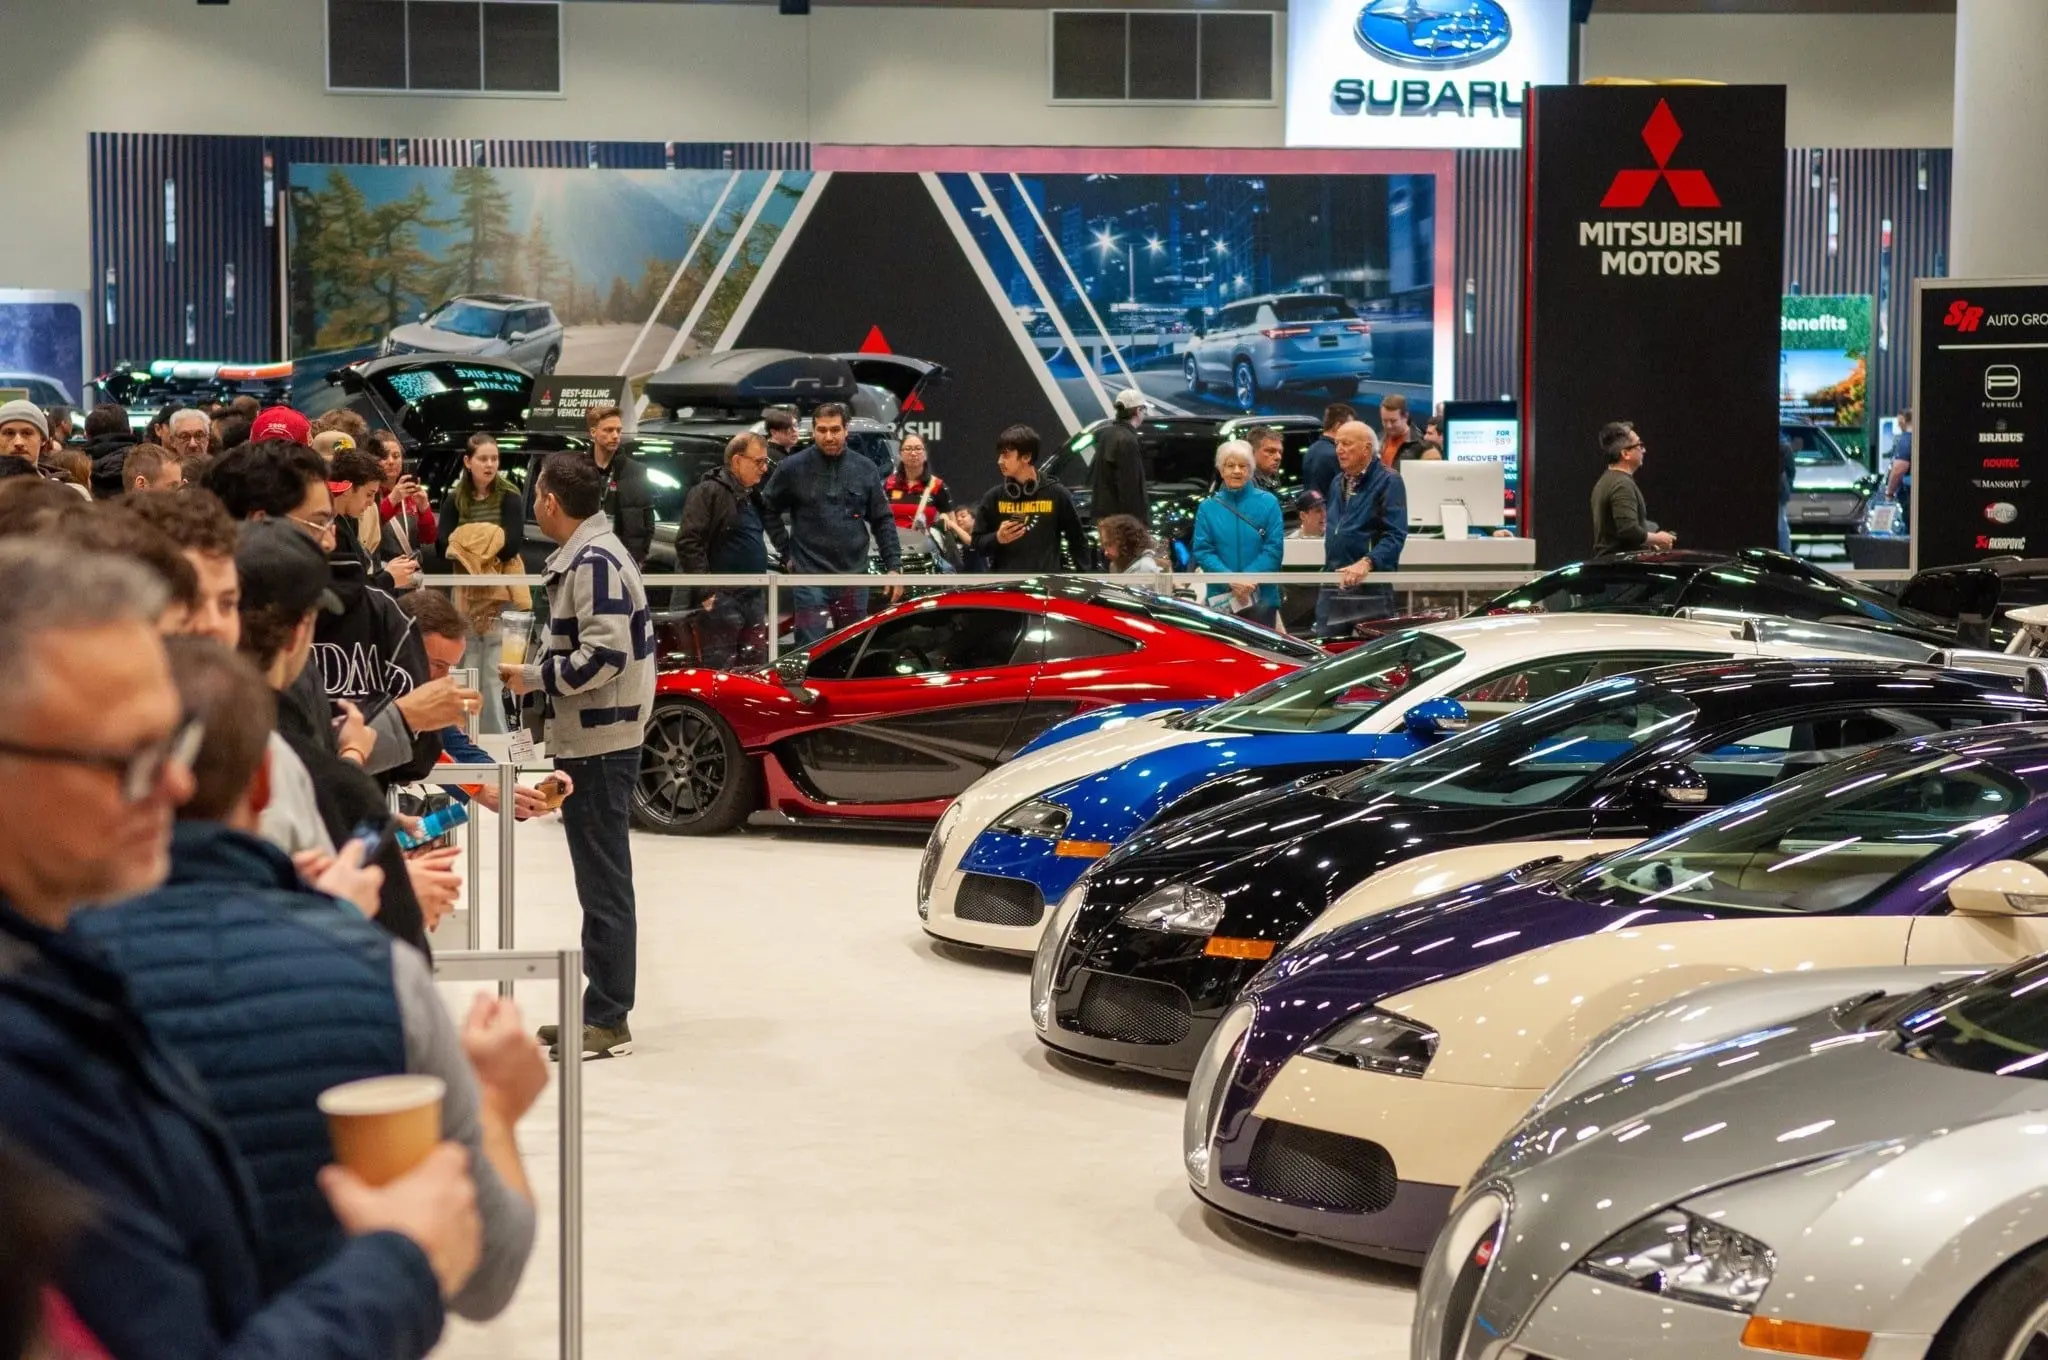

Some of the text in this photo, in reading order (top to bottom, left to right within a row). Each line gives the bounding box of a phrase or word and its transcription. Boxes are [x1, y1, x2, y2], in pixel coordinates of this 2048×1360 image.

[1333, 78, 1530, 107] SUBARU
[1579, 221, 1743, 247] MITSUBISHI
[1601, 250, 1721, 276] MOTORS
[1986, 314, 2019, 326] AUTO
[560, 388, 610, 398] BEST-SELLING
[558, 398, 587, 408] PLUG-IN
[557, 408, 586, 418] VEHICLE
[1979, 432, 2024, 443] BRABUS
[1457, 455, 1516, 463] DISCOVER THE
[1982, 479, 2021, 489] MANSORY
[998, 500, 1053, 514] WELLINGTON
